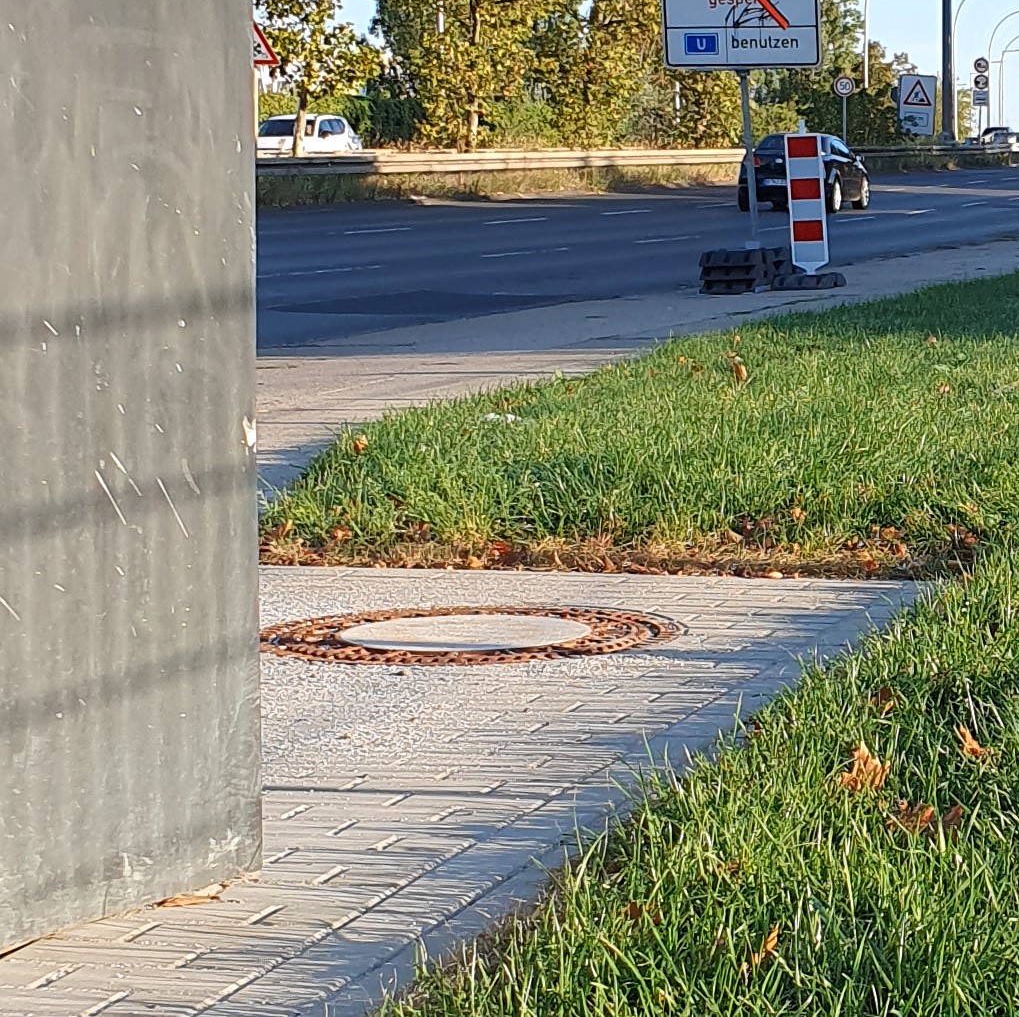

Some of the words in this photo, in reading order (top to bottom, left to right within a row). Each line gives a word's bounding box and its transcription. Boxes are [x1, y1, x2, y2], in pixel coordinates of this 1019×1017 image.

[696, 38, 707, 51] U
[730, 35, 800, 50] benutzen
[838, 81, 851, 91] 50
